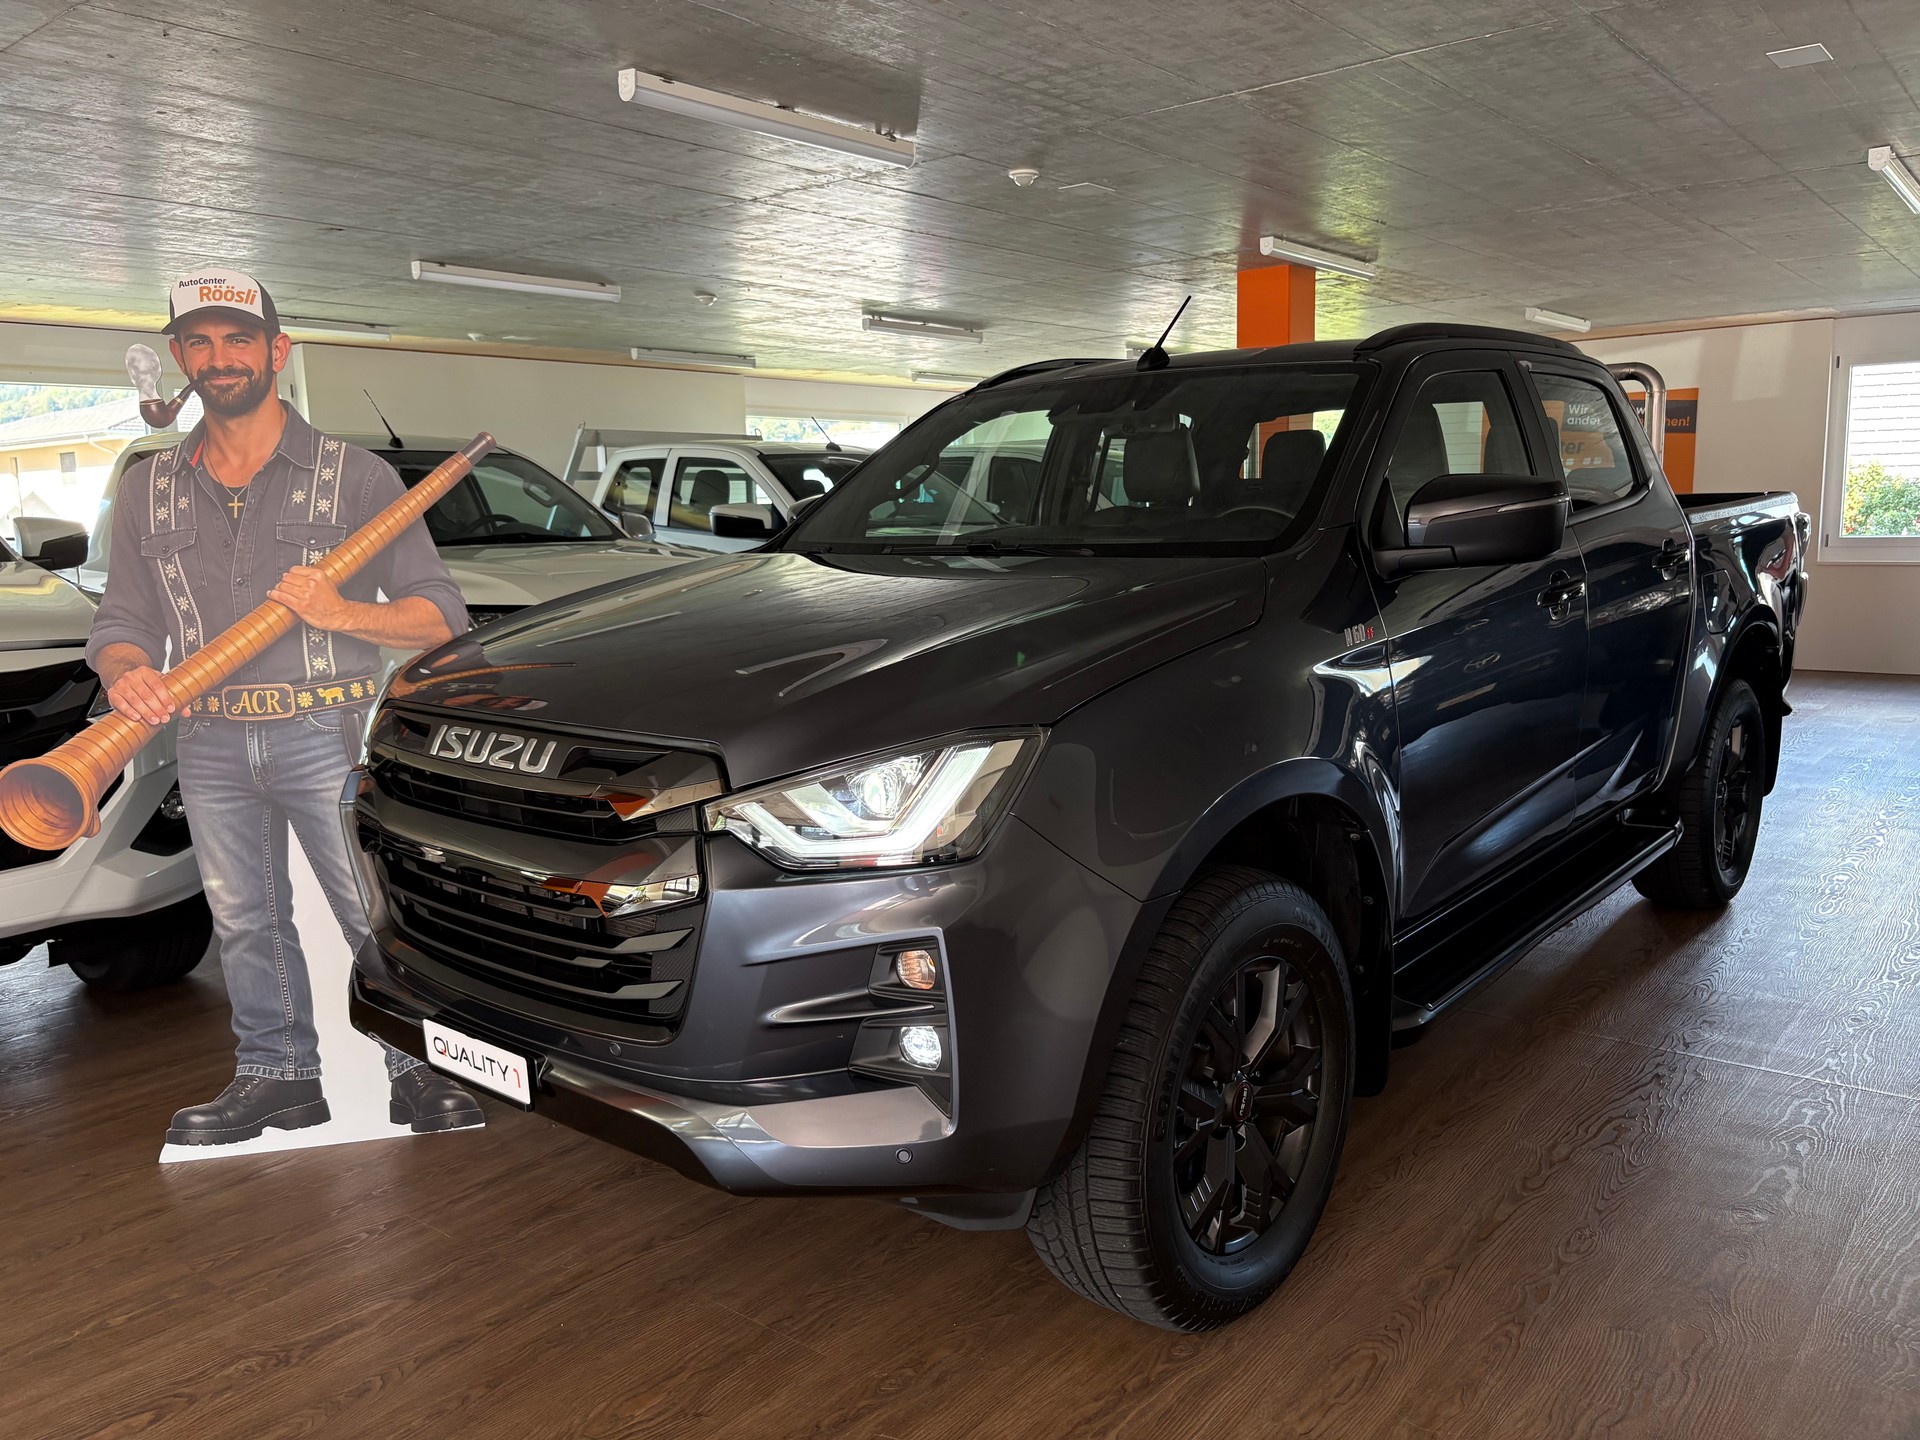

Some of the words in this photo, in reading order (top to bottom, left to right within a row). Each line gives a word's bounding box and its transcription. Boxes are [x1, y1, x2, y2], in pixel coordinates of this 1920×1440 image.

[178, 277, 227, 288] AutoCenter
[199, 285, 258, 306] Röösli
[1568, 404, 1589, 415] Wir
[231, 690, 284, 714] ACR
[430, 724, 557, 774] ISUZU
[433, 1036, 508, 1082] QUALITY
